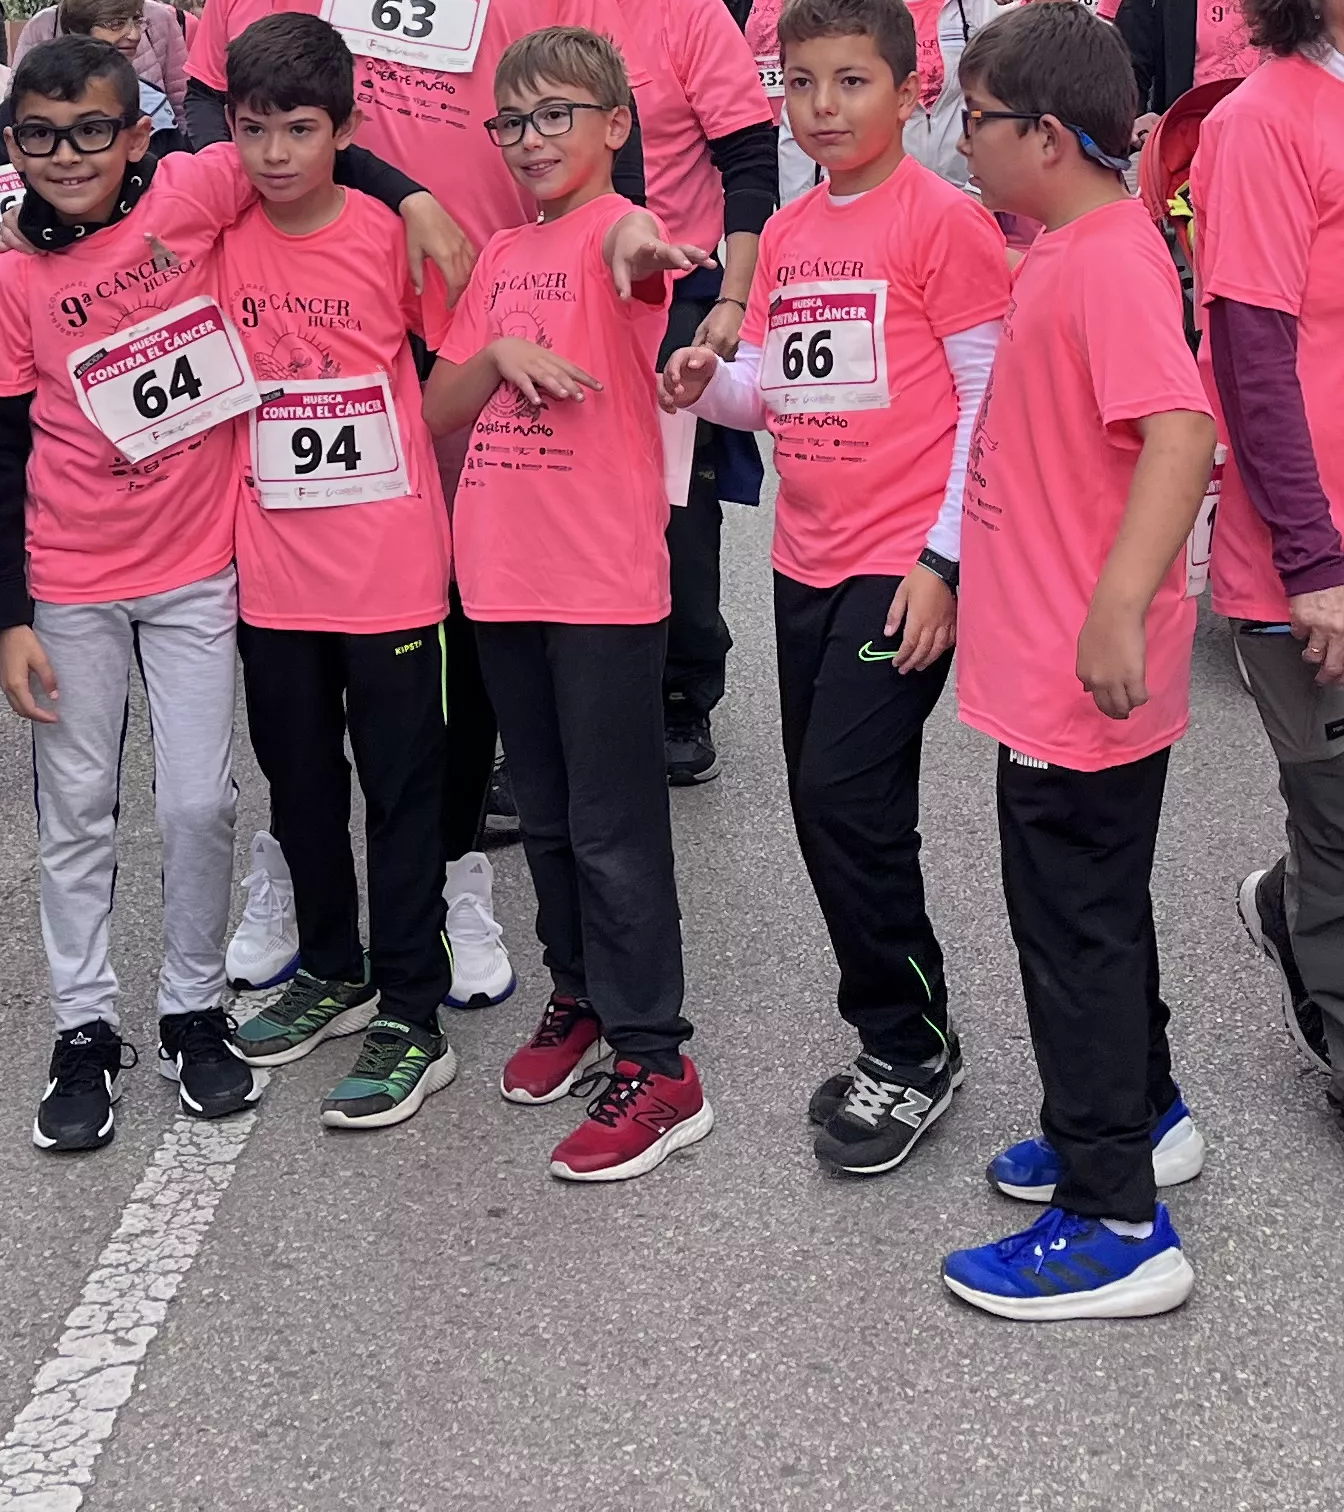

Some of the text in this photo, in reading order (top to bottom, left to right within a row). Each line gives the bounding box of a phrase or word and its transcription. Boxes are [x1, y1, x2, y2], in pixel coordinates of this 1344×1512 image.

[415, 80, 456, 95] MUCHO
[144, 259, 197, 293] HUESCA
[799, 256, 865, 279] CÁNCER
[508, 271, 568, 292] CÁNCER
[269, 291, 350, 317] CÁNCER
[792, 297, 824, 310] HUESCA
[801, 309, 814, 322] EL
[815, 304, 867, 321] CÁNCER
[307, 315, 363, 332] HUESCA
[86, 319, 217, 385] CONTRA EL CÁNCER
[128, 329, 171, 354] HUESCA
[782, 329, 834, 381] 66
[132, 354, 203, 419] 64
[262, 399, 384, 420] CONTRA EL CÁNCER
[302, 393, 344, 406] HUESCA
[513, 421, 554, 437] MUCHO
[807, 415, 848, 429] MUCHO
[291, 424, 362, 476] 94
